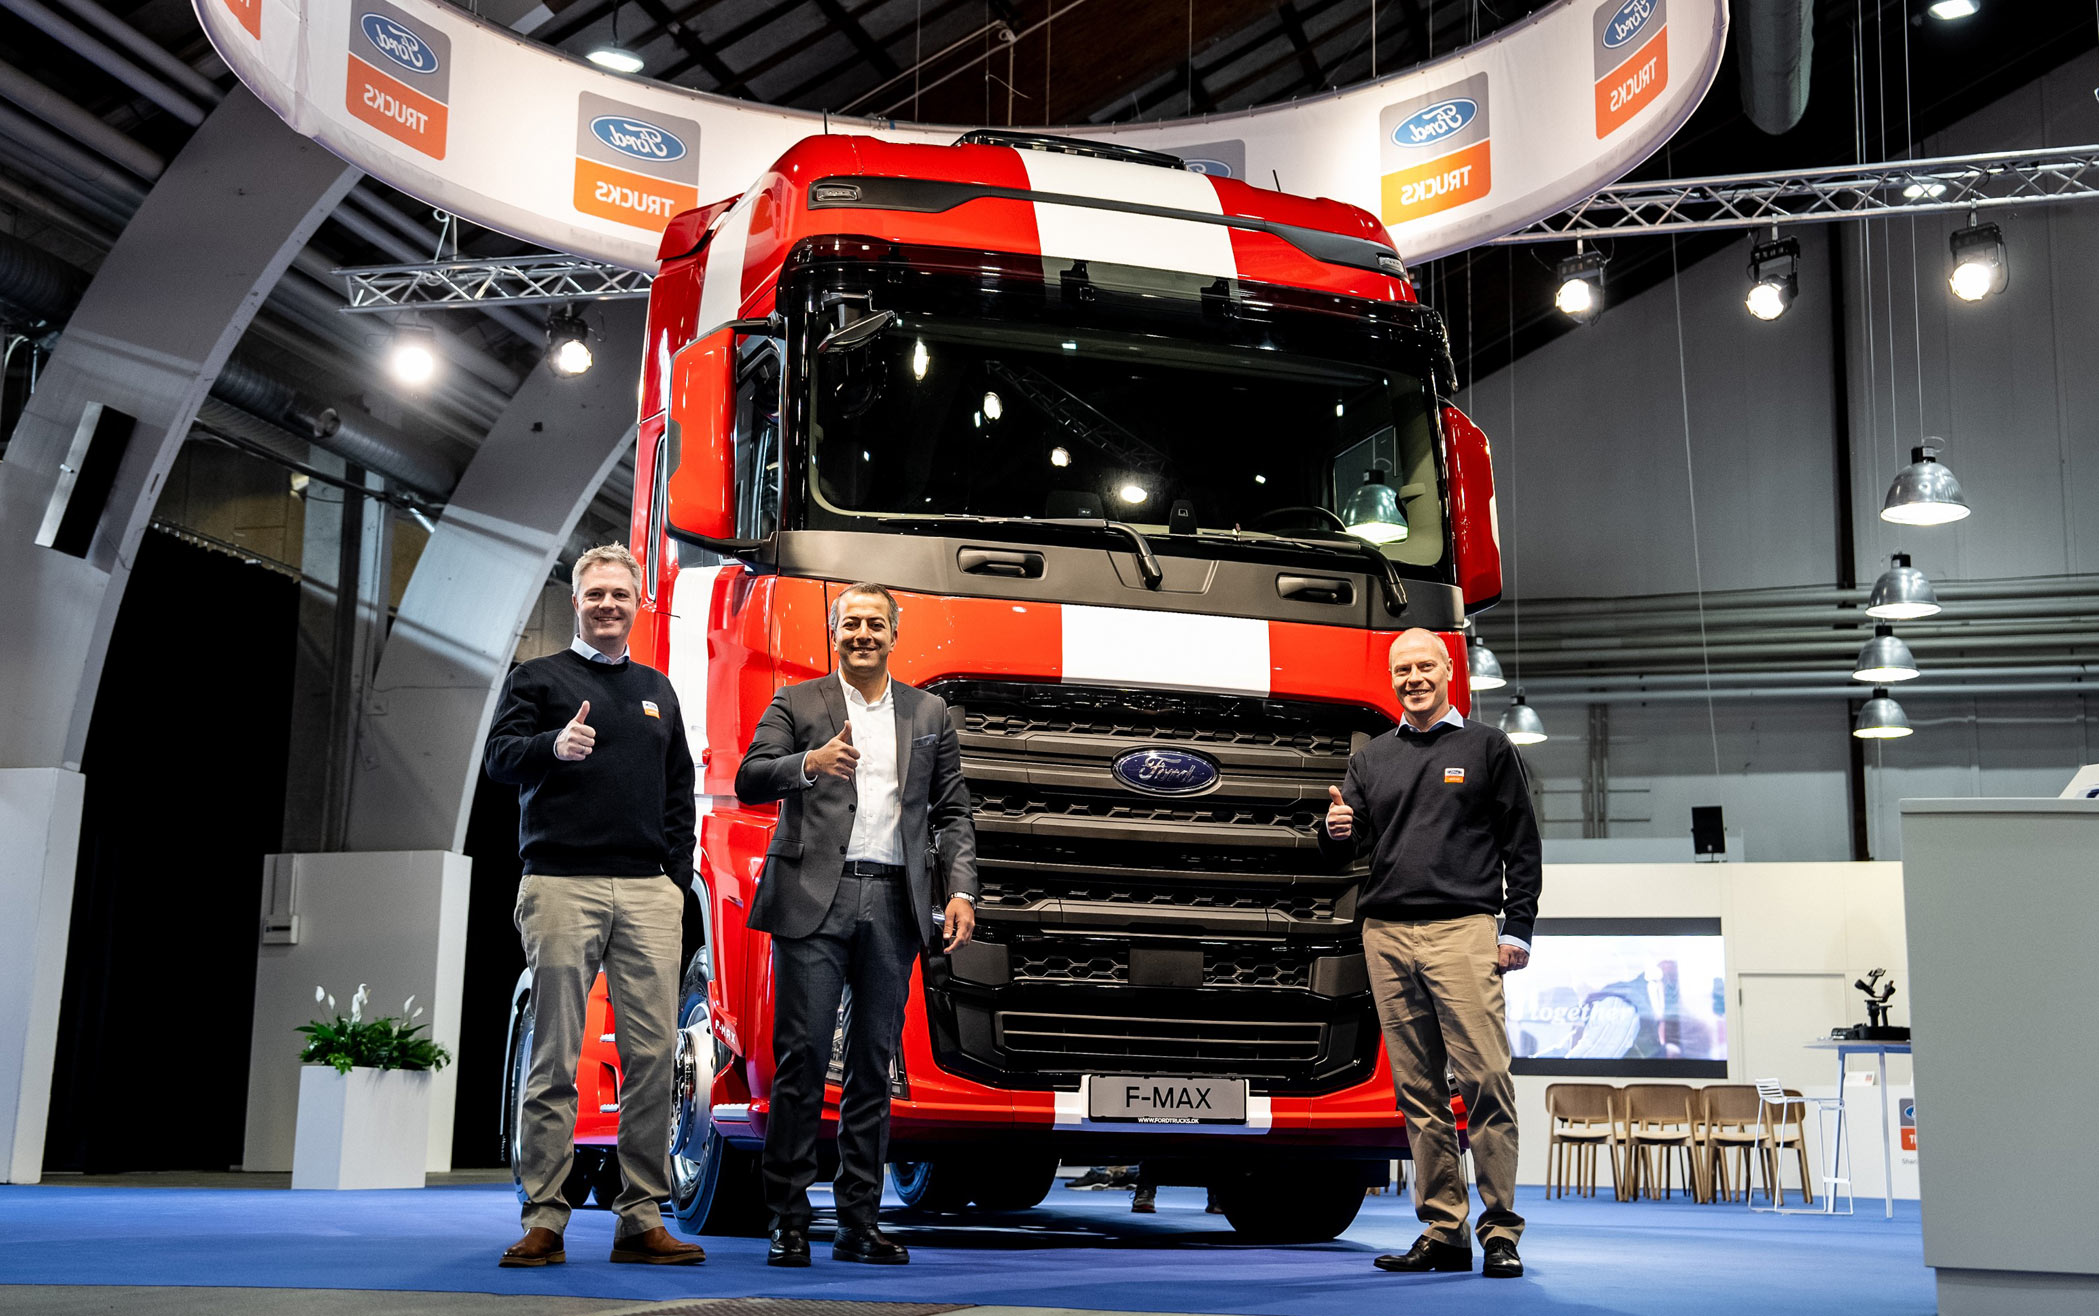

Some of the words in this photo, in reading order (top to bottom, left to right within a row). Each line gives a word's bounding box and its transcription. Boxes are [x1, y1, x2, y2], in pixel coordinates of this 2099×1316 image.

[1138, 753, 1196, 782] Ford
[715, 1019, 736, 1044] F-MAX
[1126, 1086, 1212, 1109] F-MAX
